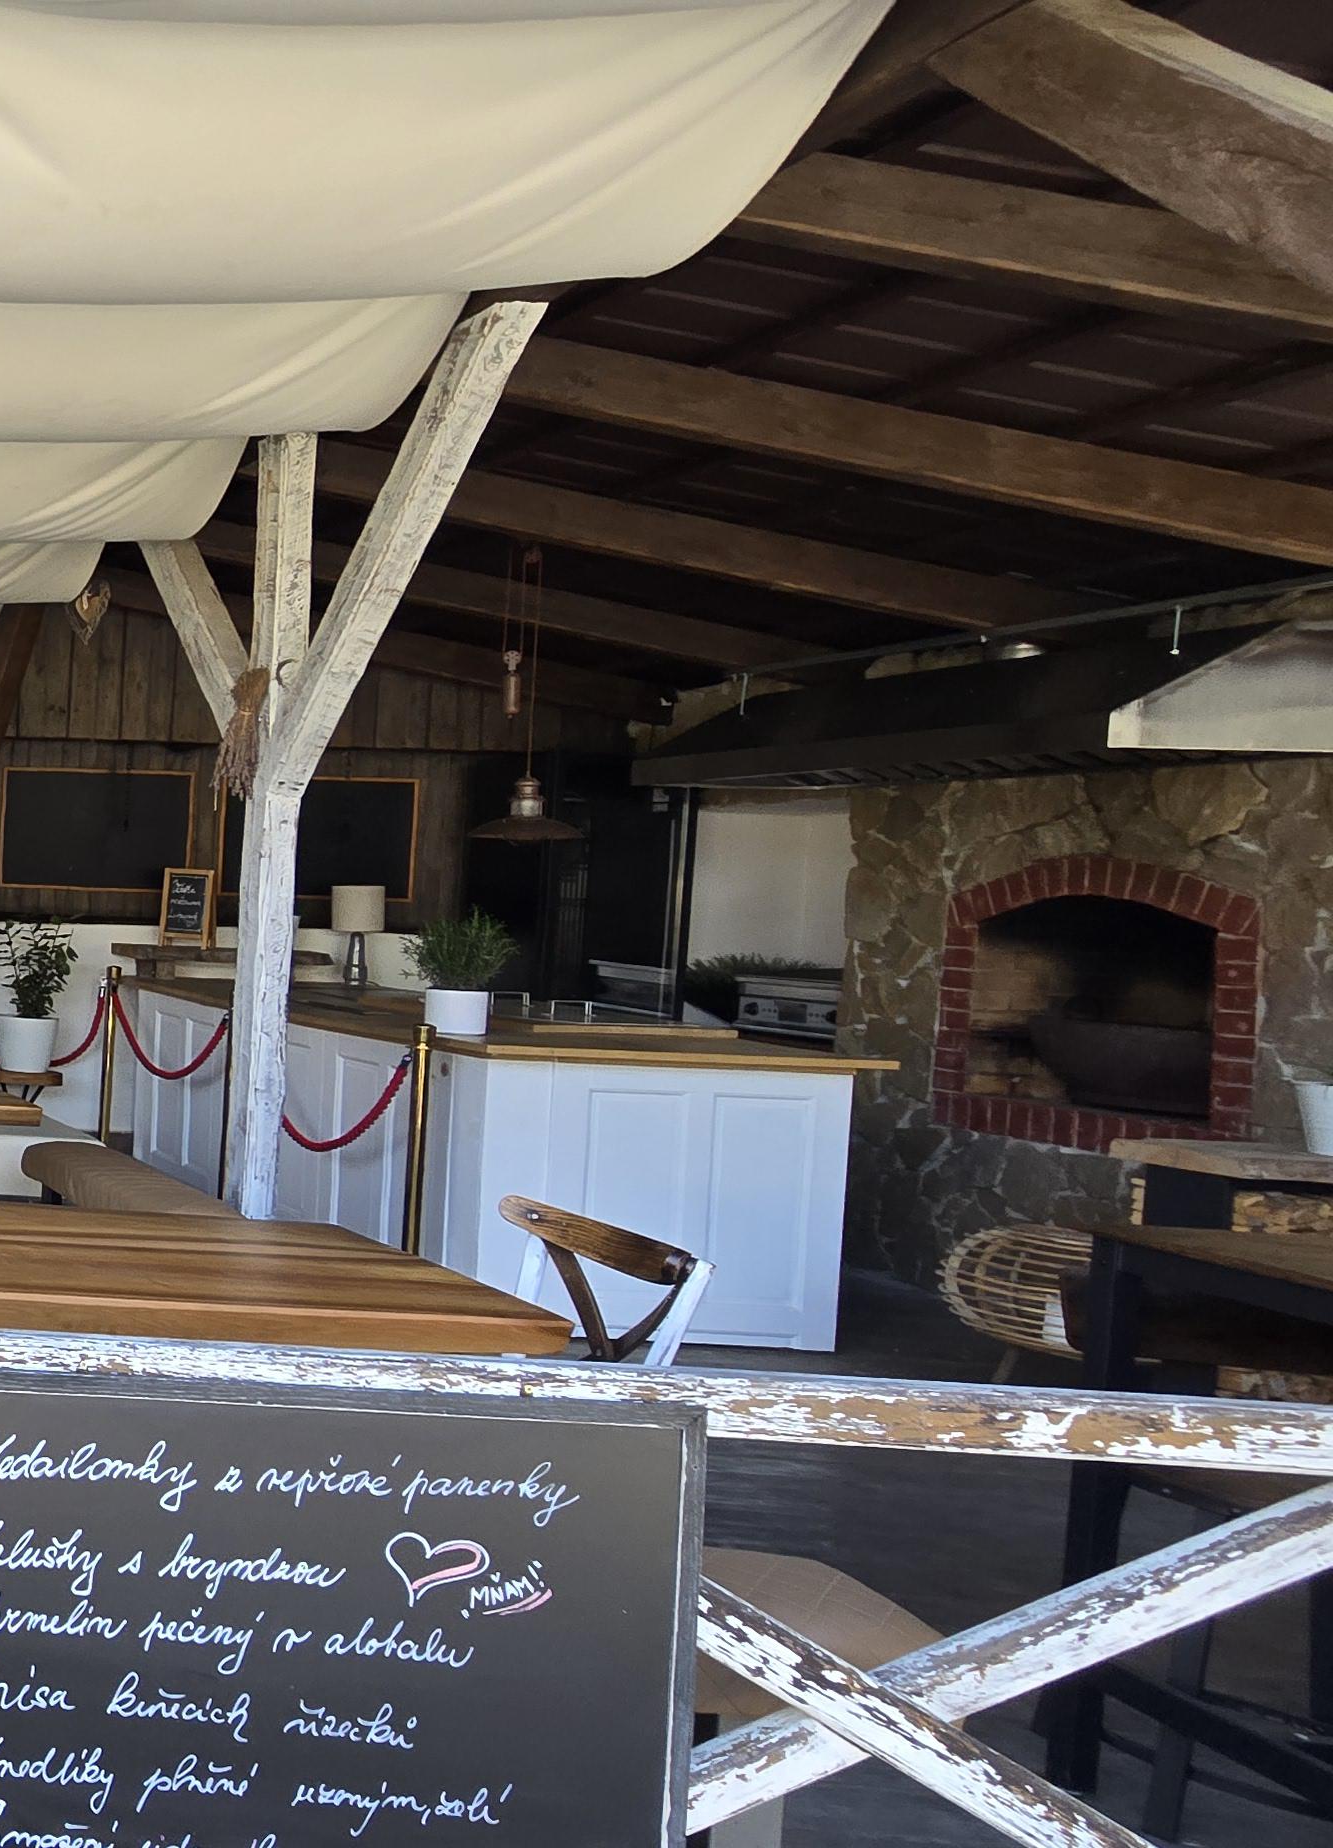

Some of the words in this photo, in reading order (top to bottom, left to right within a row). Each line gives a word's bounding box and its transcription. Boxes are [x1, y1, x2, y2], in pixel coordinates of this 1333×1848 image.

[215, 1466, 243, 1493] z
[402, 1462, 581, 1527] panenky
[118, 1551, 143, 1574] s
[139, 1607, 266, 1675] pečený
